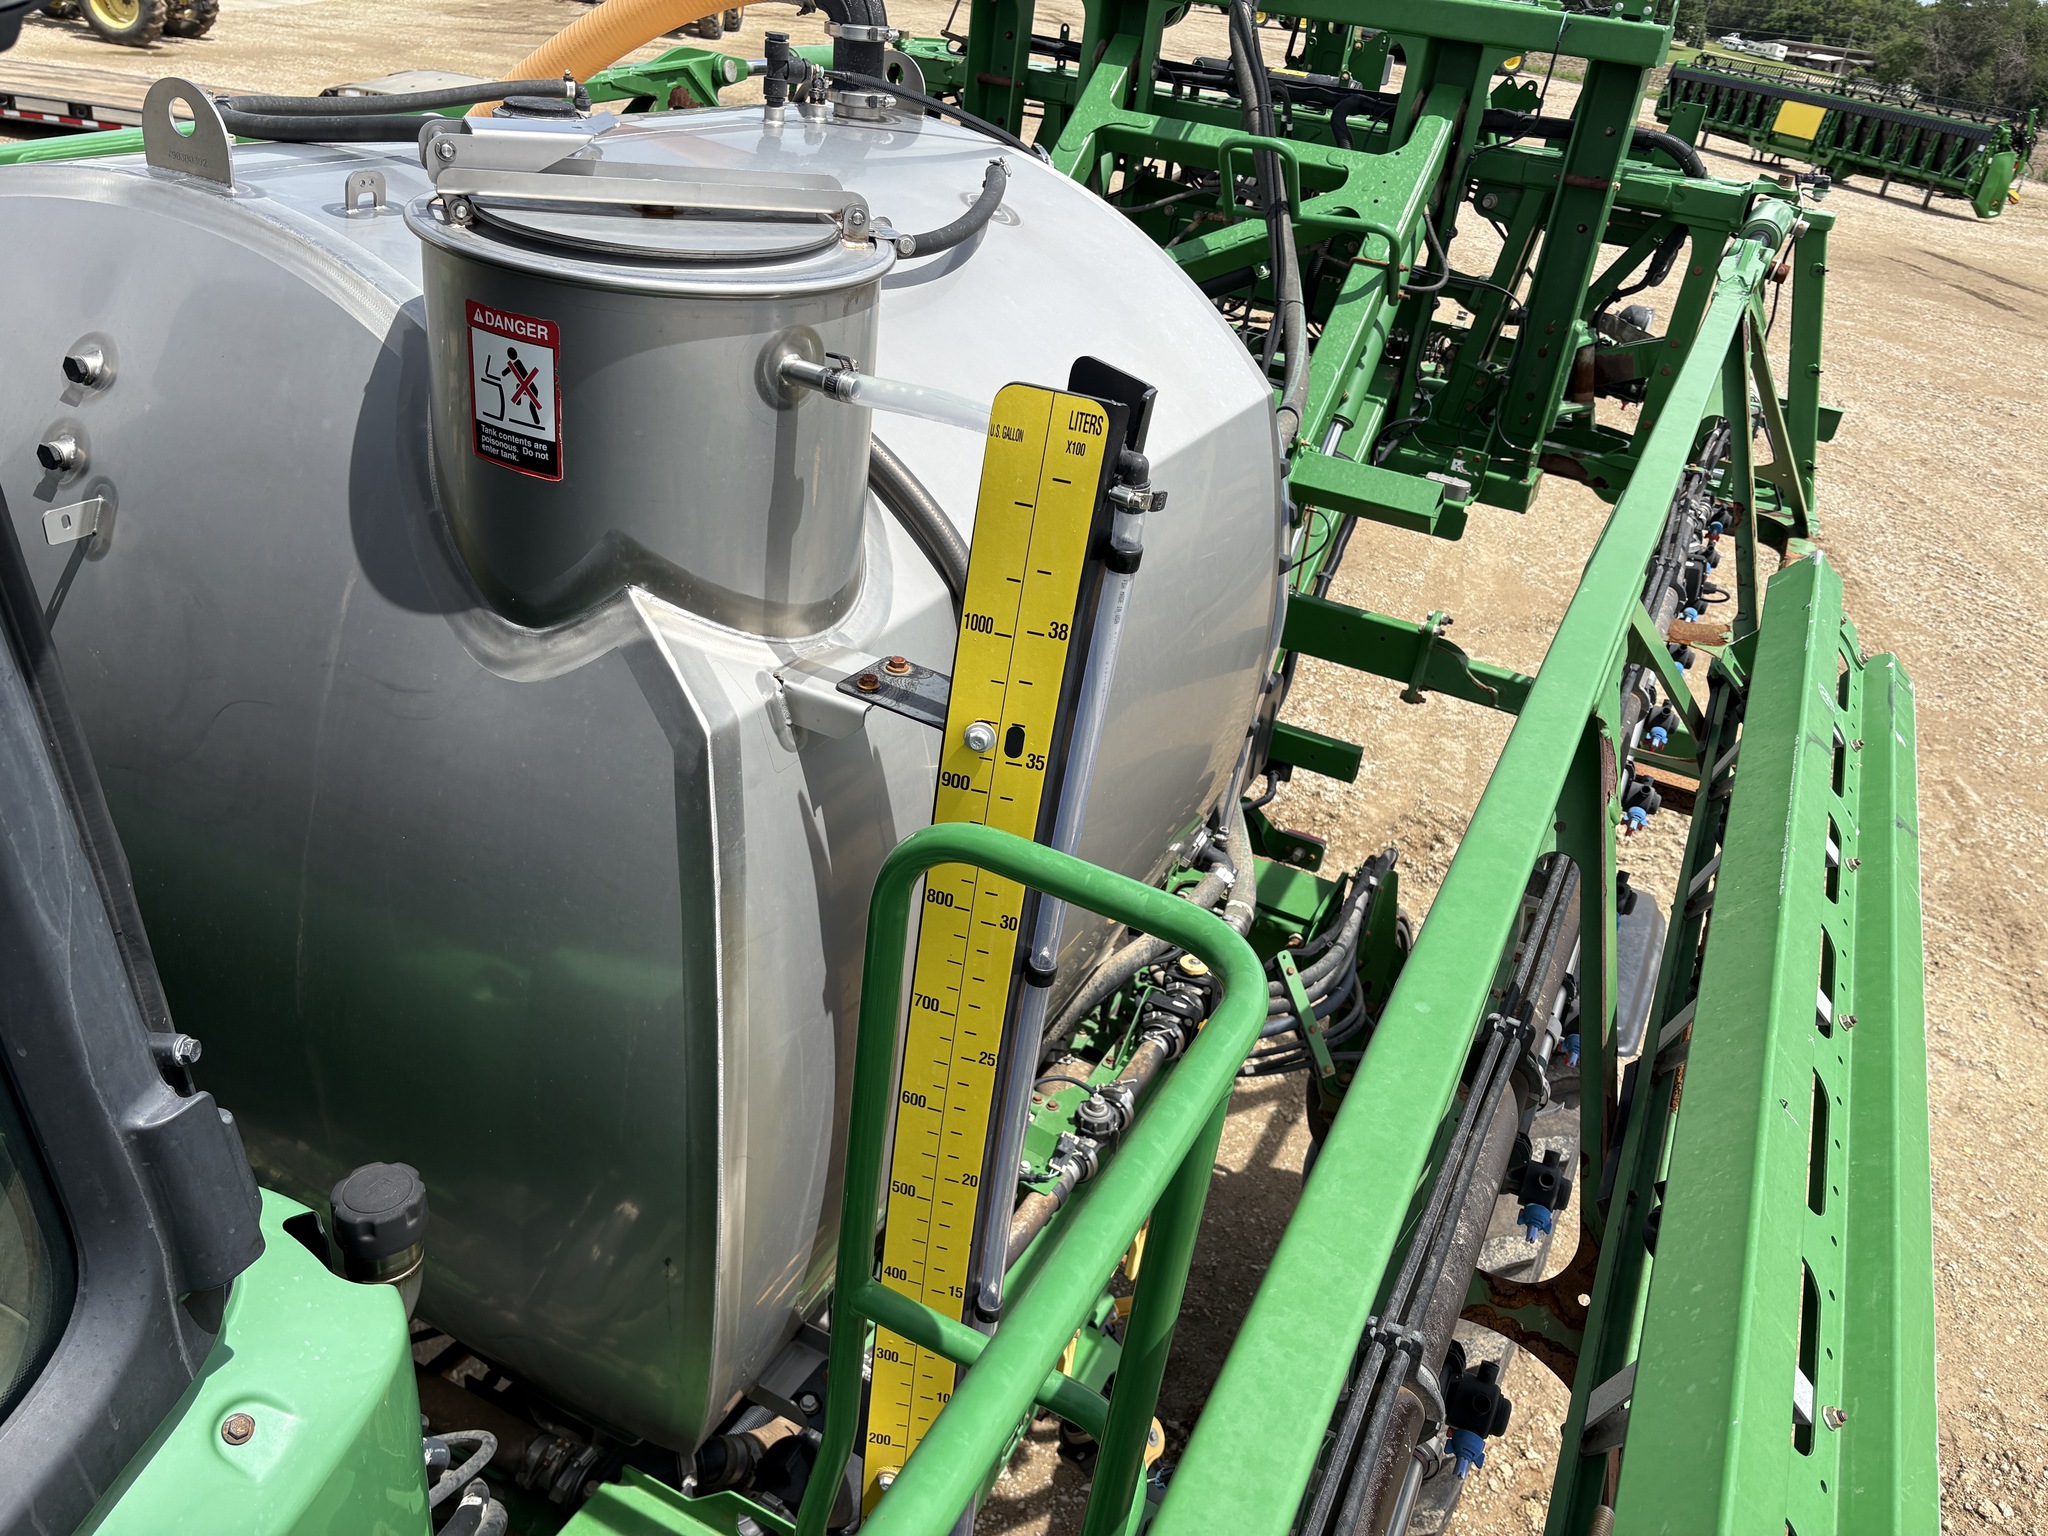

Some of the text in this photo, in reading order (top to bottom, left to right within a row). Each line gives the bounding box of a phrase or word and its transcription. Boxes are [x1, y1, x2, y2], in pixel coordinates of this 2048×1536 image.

[485, 311, 549, 341] DANGER
[1068, 410, 1104, 437] LITERS
[481, 424, 548, 451] Tank contents are
[990, 424, 1025, 443] U.S. GALLON
[481, 434, 549, 461] poisonous. Do not
[481, 444, 519, 462] enter tank.
[1065, 440, 1086, 457] X100
[964, 613, 994, 634] 1000
[1048, 621, 1069, 641] 38
[1025, 753, 1045, 771] 35
[941, 771, 970, 791] 900
[926, 888, 954, 908] 800
[999, 915, 1018, 932] 30
[914, 992, 940, 1012] 700
[978, 1051, 996, 1067] 25
[902, 1090, 927, 1108] 600
[891, 1181, 916, 1198] 500
[961, 1173, 978, 1188] 20
[883, 1266, 907, 1281] 400
[948, 1286, 963, 1299] 15
[876, 1347, 899, 1363] 300
[936, 1392, 951, 1404] 10
[868, 1432, 891, 1446] 200
